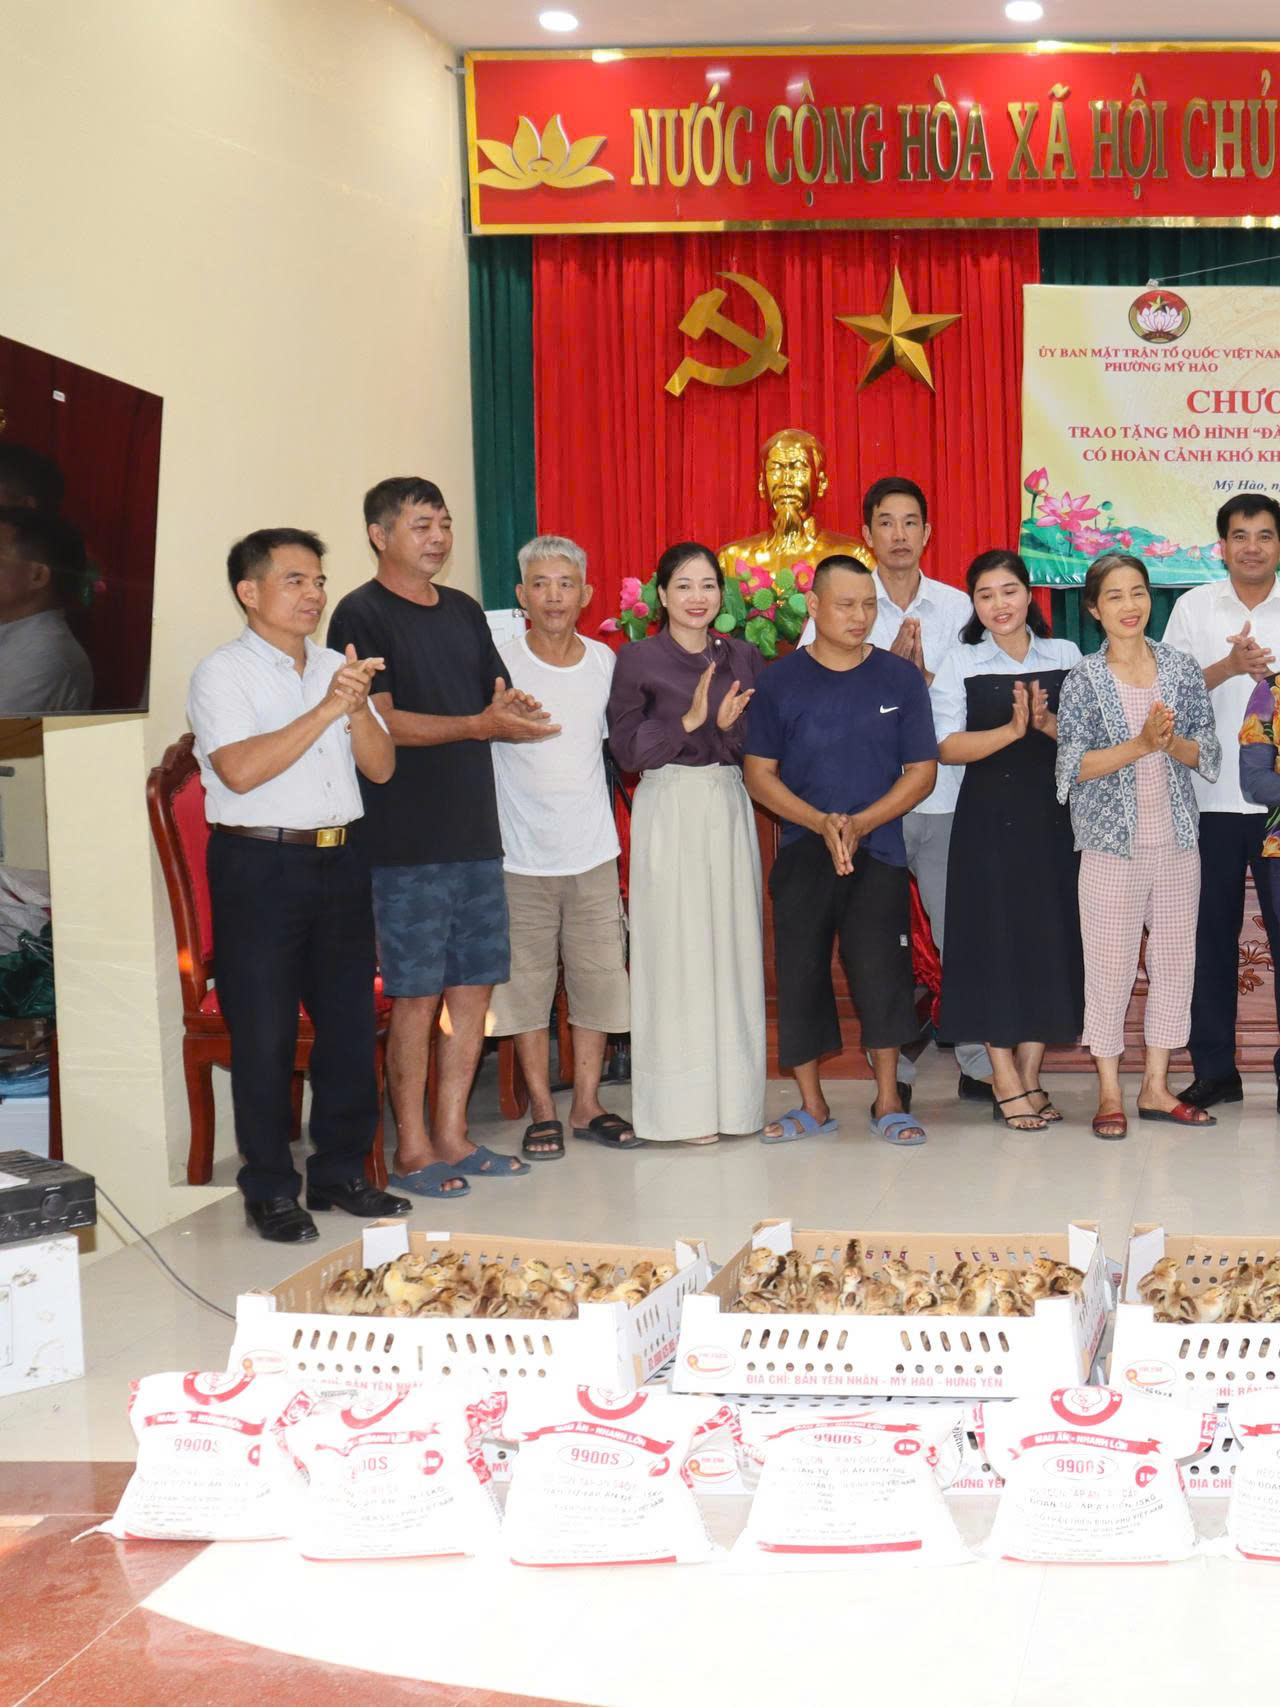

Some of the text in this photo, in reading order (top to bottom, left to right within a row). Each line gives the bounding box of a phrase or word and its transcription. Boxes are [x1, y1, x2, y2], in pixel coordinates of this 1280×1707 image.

[630, 82, 752, 187] NƯỚC
[765, 81, 886, 207] CỘNG
[899, 74, 993, 183] HÒA
[1007, 82, 1076, 181] XÃ
[1090, 73, 1167, 200] HỘI
[1183, 69, 1278, 180] CHỦ
[1060, 348, 1088, 358] BAN
[1091, 347, 1121, 360] MẶT
[1124, 346, 1158, 360] TRẬN
[1161, 346, 1179, 359] TỔ
[1182, 346, 1220, 360] QUỐC
[1224, 347, 1253, 360] VIỆT
[1104, 361, 1218, 373] PHƯỜNG MỸ HÀO
[1069, 426, 1116, 439] TRAO
[1120, 424, 1168, 441] TẶNG
[1172, 424, 1200, 440] MÔ
[1204, 424, 1248, 440] HÌNH
[1083, 448, 1107, 462] CÓ
[1111, 448, 1159, 462] HOÀN
[1164, 448, 1211, 462] CẢNH
[1217, 448, 1252, 463] KHÓ
[1213, 480, 1234, 493] Mỹ
[570, 1447, 620, 1466] 9900S
[1055, 1459, 1106, 1475] 9900S
